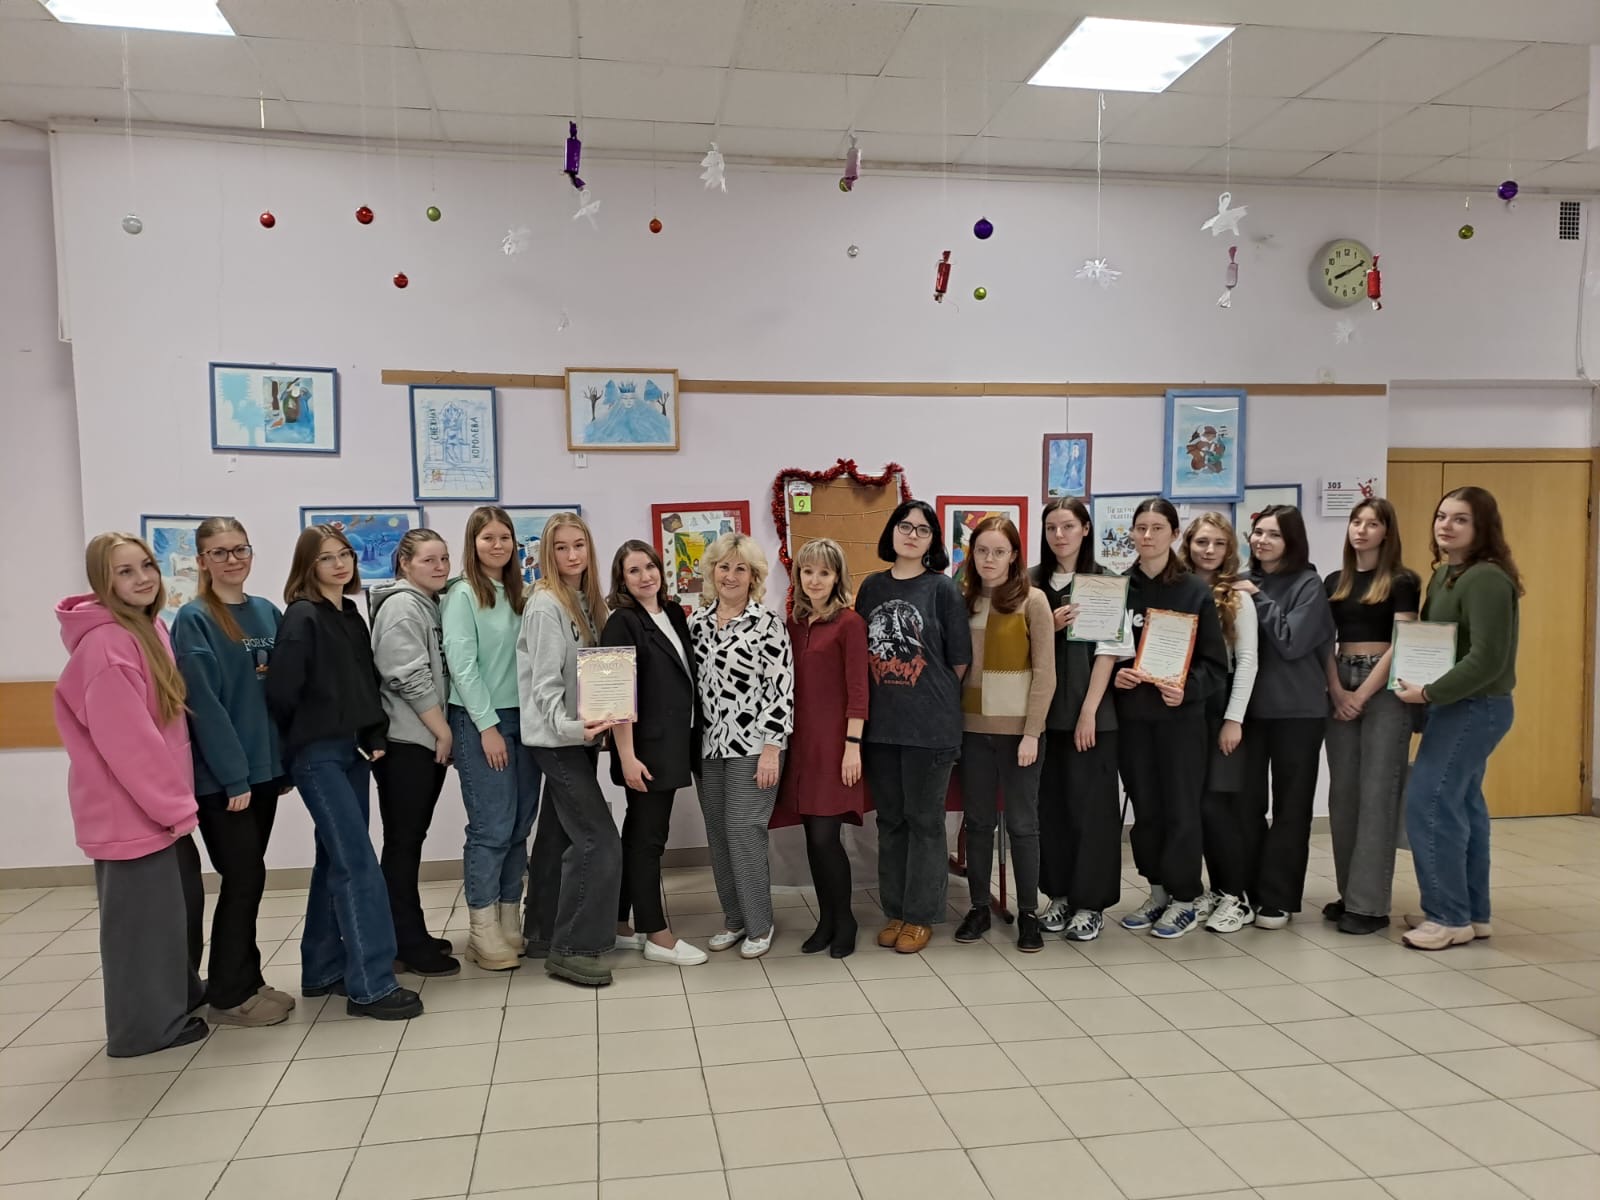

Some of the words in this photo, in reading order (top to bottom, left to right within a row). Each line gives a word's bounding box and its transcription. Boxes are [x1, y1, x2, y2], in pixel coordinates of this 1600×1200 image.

[1336, 250, 1341, 258] 11
[1344, 248, 1351, 256] 12
[1328, 278, 1332, 286] 8
[1343, 289, 1347, 297] 6
[470, 417, 480, 458] КОРОЛЕВА
[798, 499, 805, 511] 9
